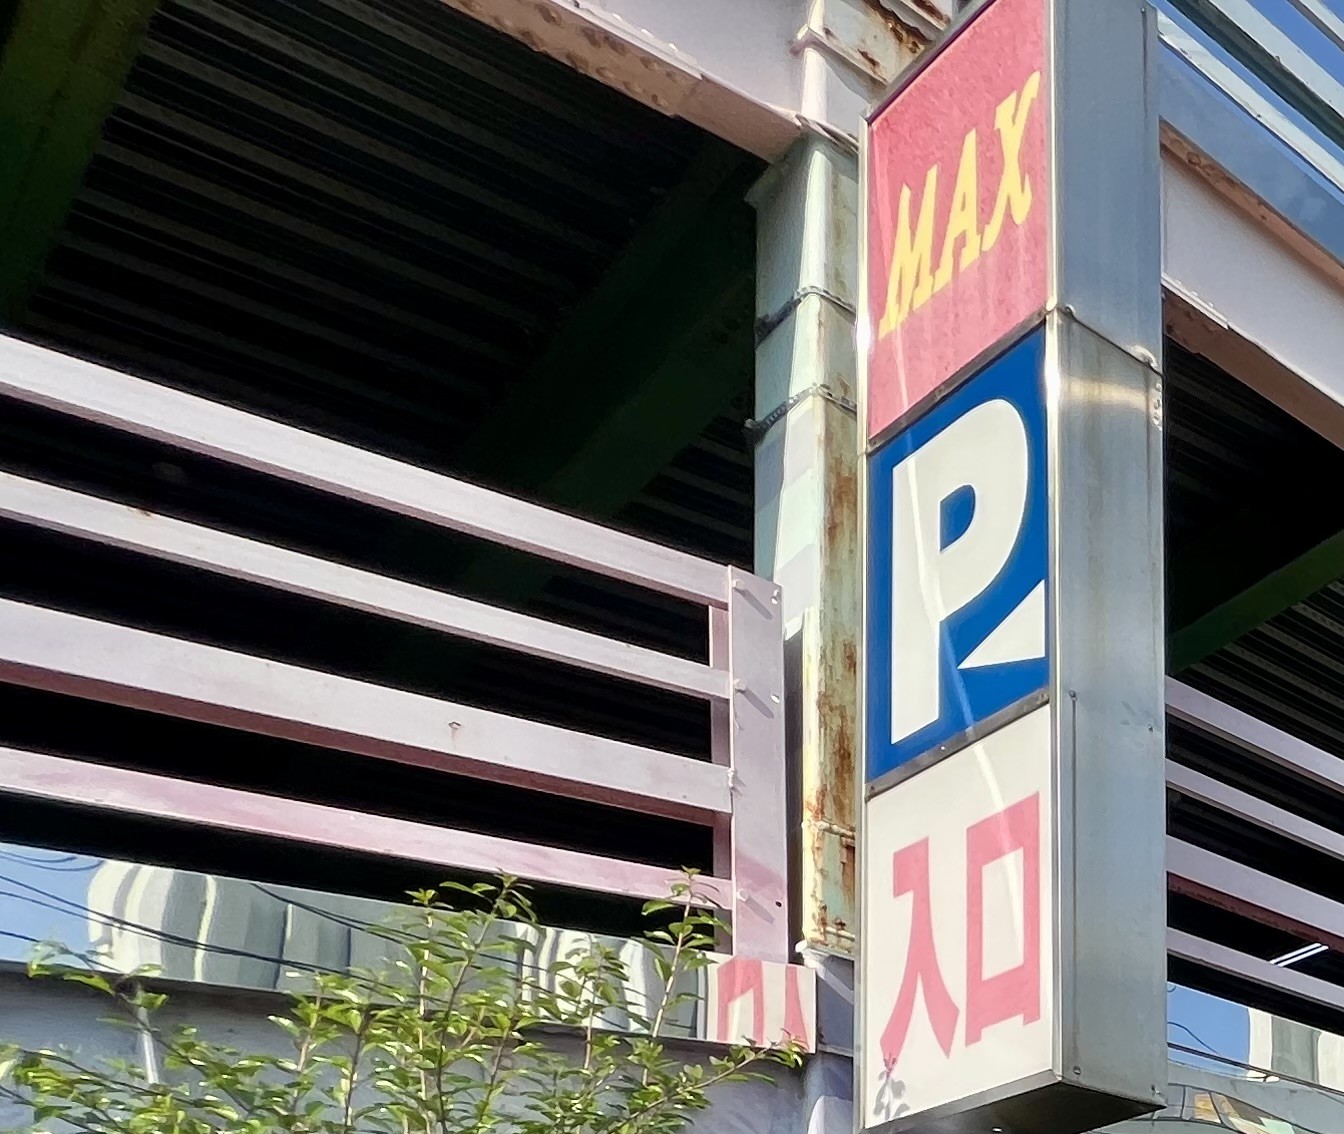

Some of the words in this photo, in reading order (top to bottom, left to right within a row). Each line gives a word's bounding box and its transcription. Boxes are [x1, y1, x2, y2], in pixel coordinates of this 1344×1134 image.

[878, 71, 1041, 341] MAX
[891, 399, 1029, 745] P
[880, 790, 1042, 1063] 入口
